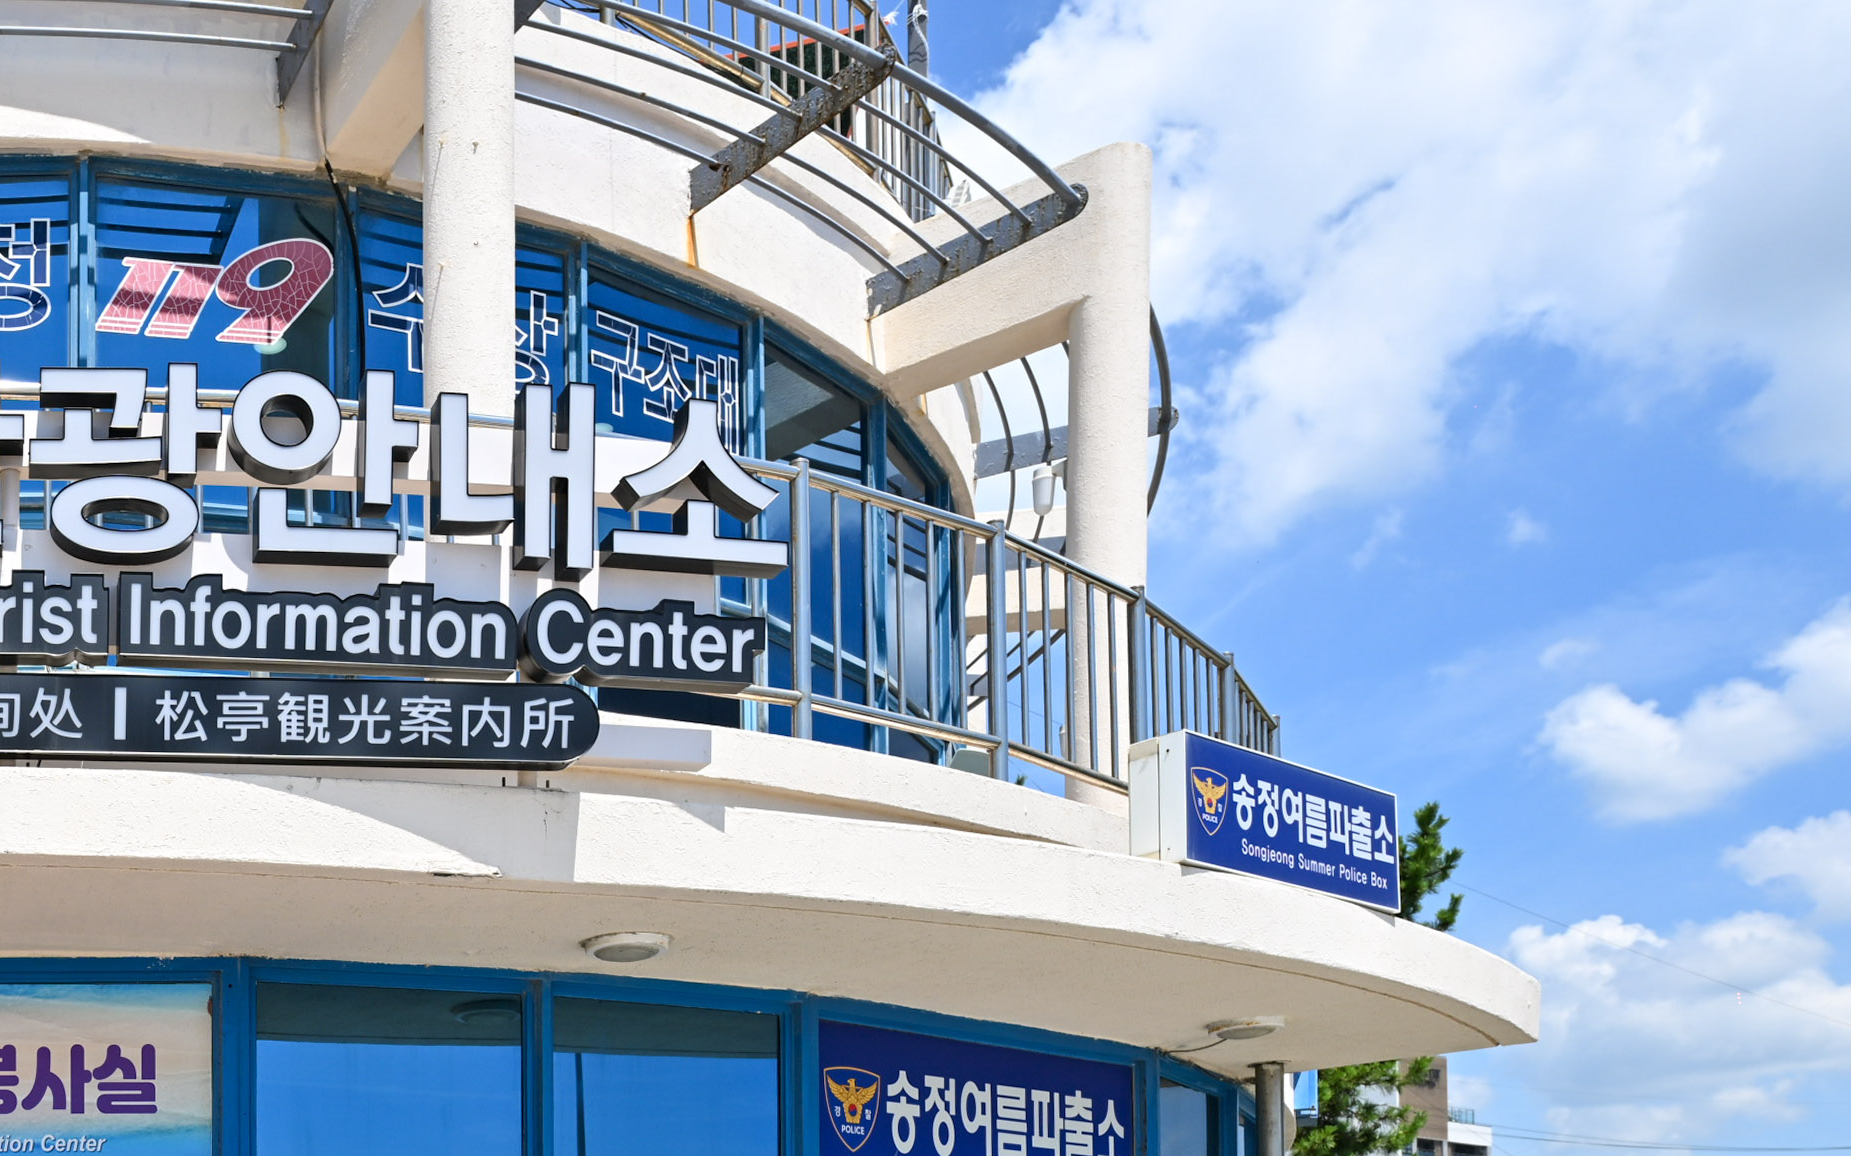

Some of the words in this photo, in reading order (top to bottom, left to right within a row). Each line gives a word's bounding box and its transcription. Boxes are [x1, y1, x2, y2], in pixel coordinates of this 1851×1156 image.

[95, 238, 334, 345] 119
[128, 582, 507, 661] Information
[536, 599, 755, 673] Center
[154, 689, 576, 750] 松亭観光案内所
[1202, 813, 1218, 824] POLICE
[1232, 773, 1395, 865] 송정여름파출소
[1241, 838, 1295, 869] Songjeong
[1298, 852, 1336, 877] Summer
[1339, 863, 1368, 885] Police
[1371, 871, 1388, 890] Box
[40, 1134, 107, 1153] Center
[841, 1124, 865, 1136] POLICE
